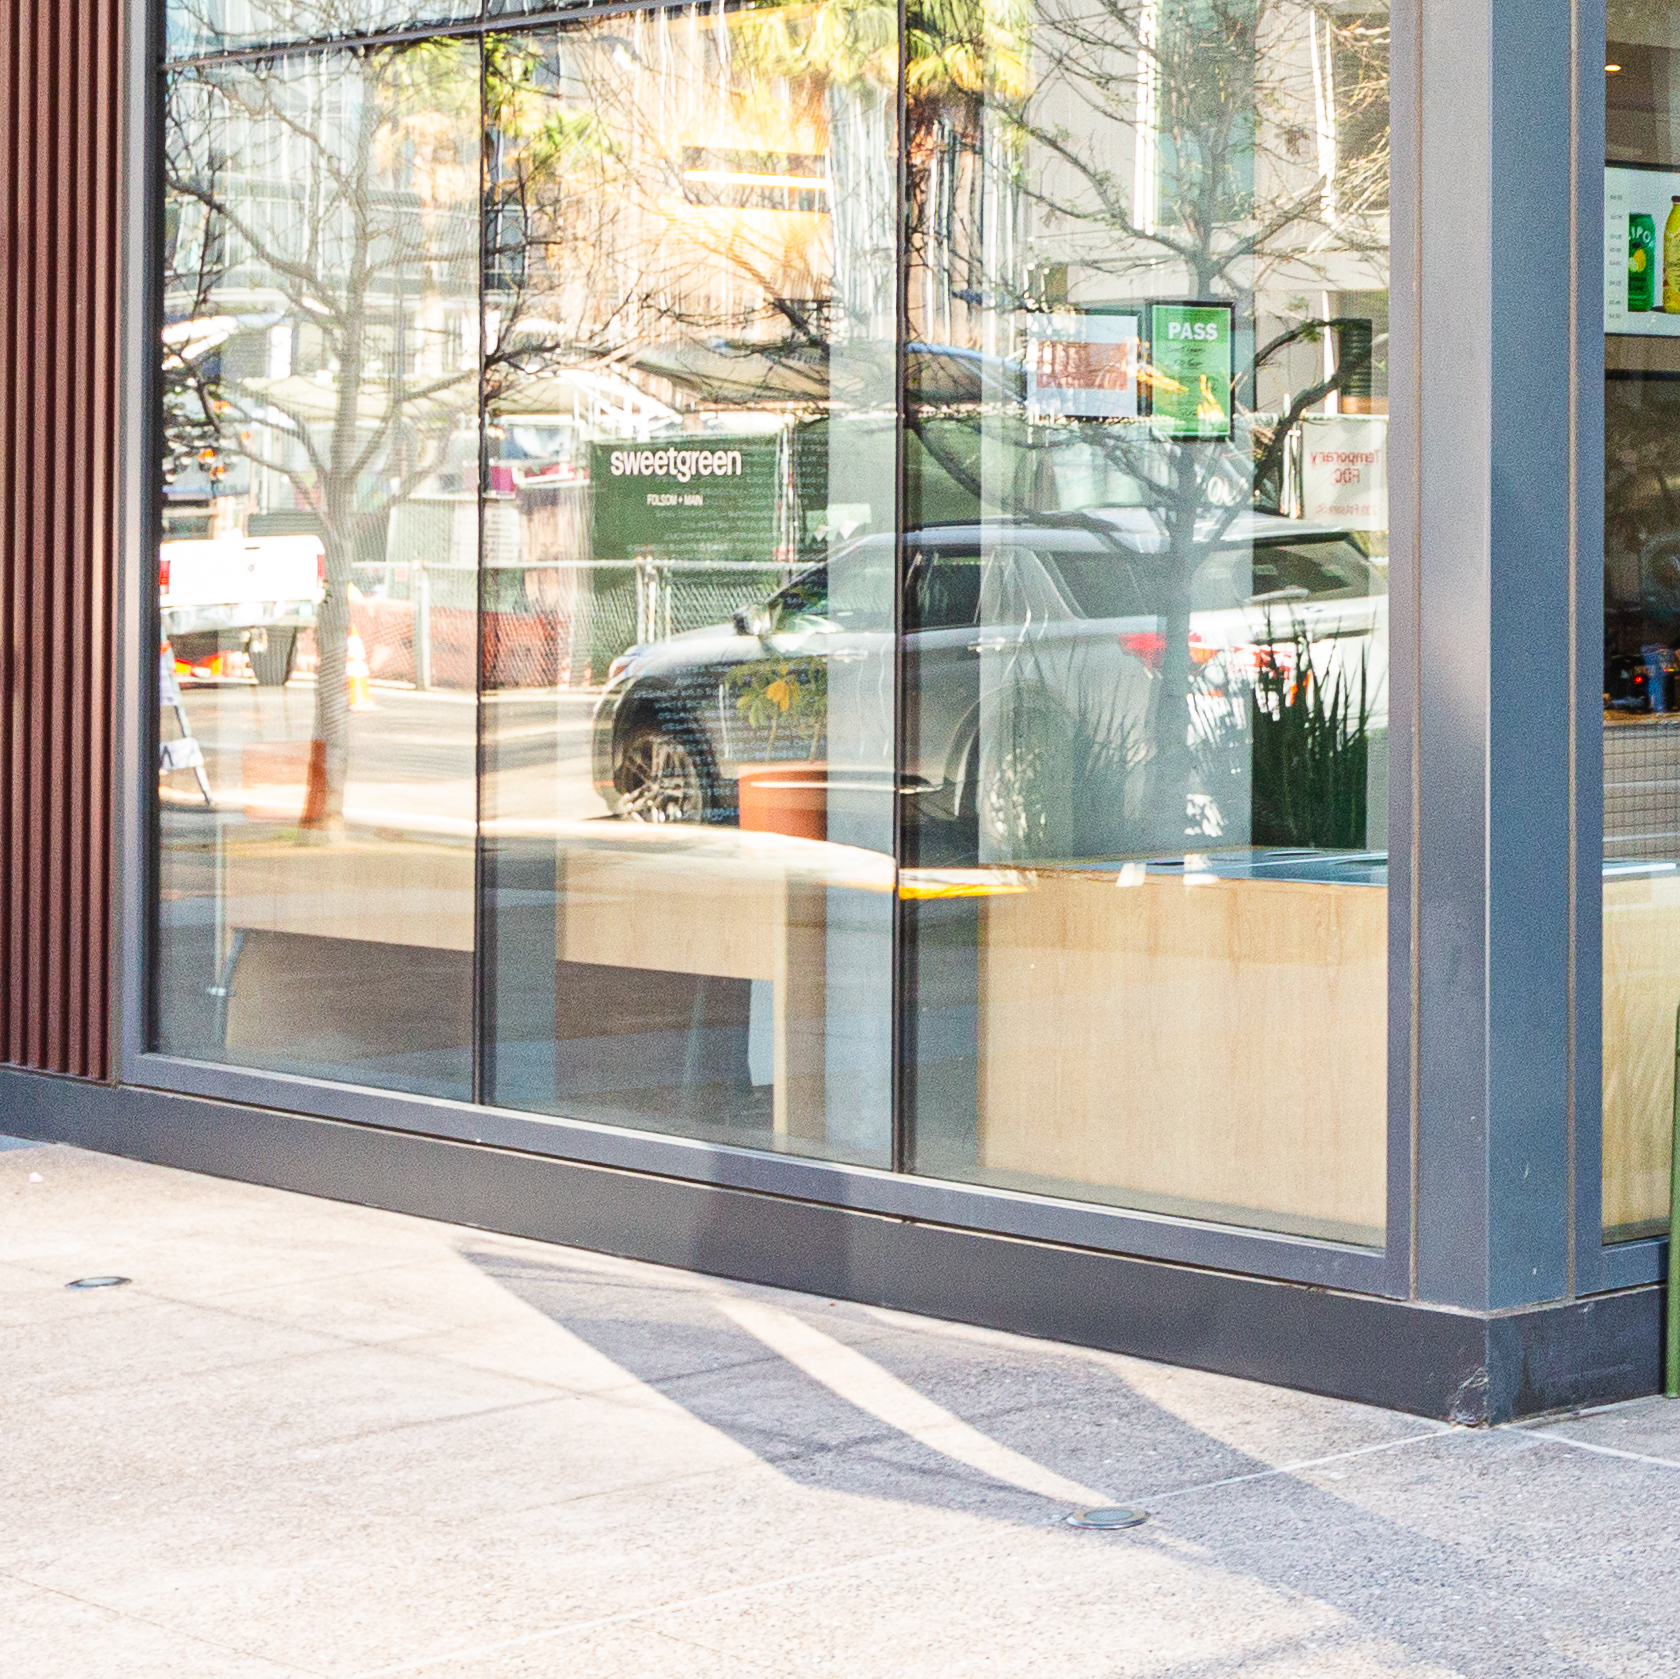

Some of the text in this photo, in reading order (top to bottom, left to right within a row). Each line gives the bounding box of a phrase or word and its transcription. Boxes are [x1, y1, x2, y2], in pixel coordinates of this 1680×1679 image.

[1167, 321, 1219, 341] PASS
[610, 447, 742, 483] sweetgreen
[646, 494, 677, 506] FOLSOM
[684, 494, 704, 506] MAIN
